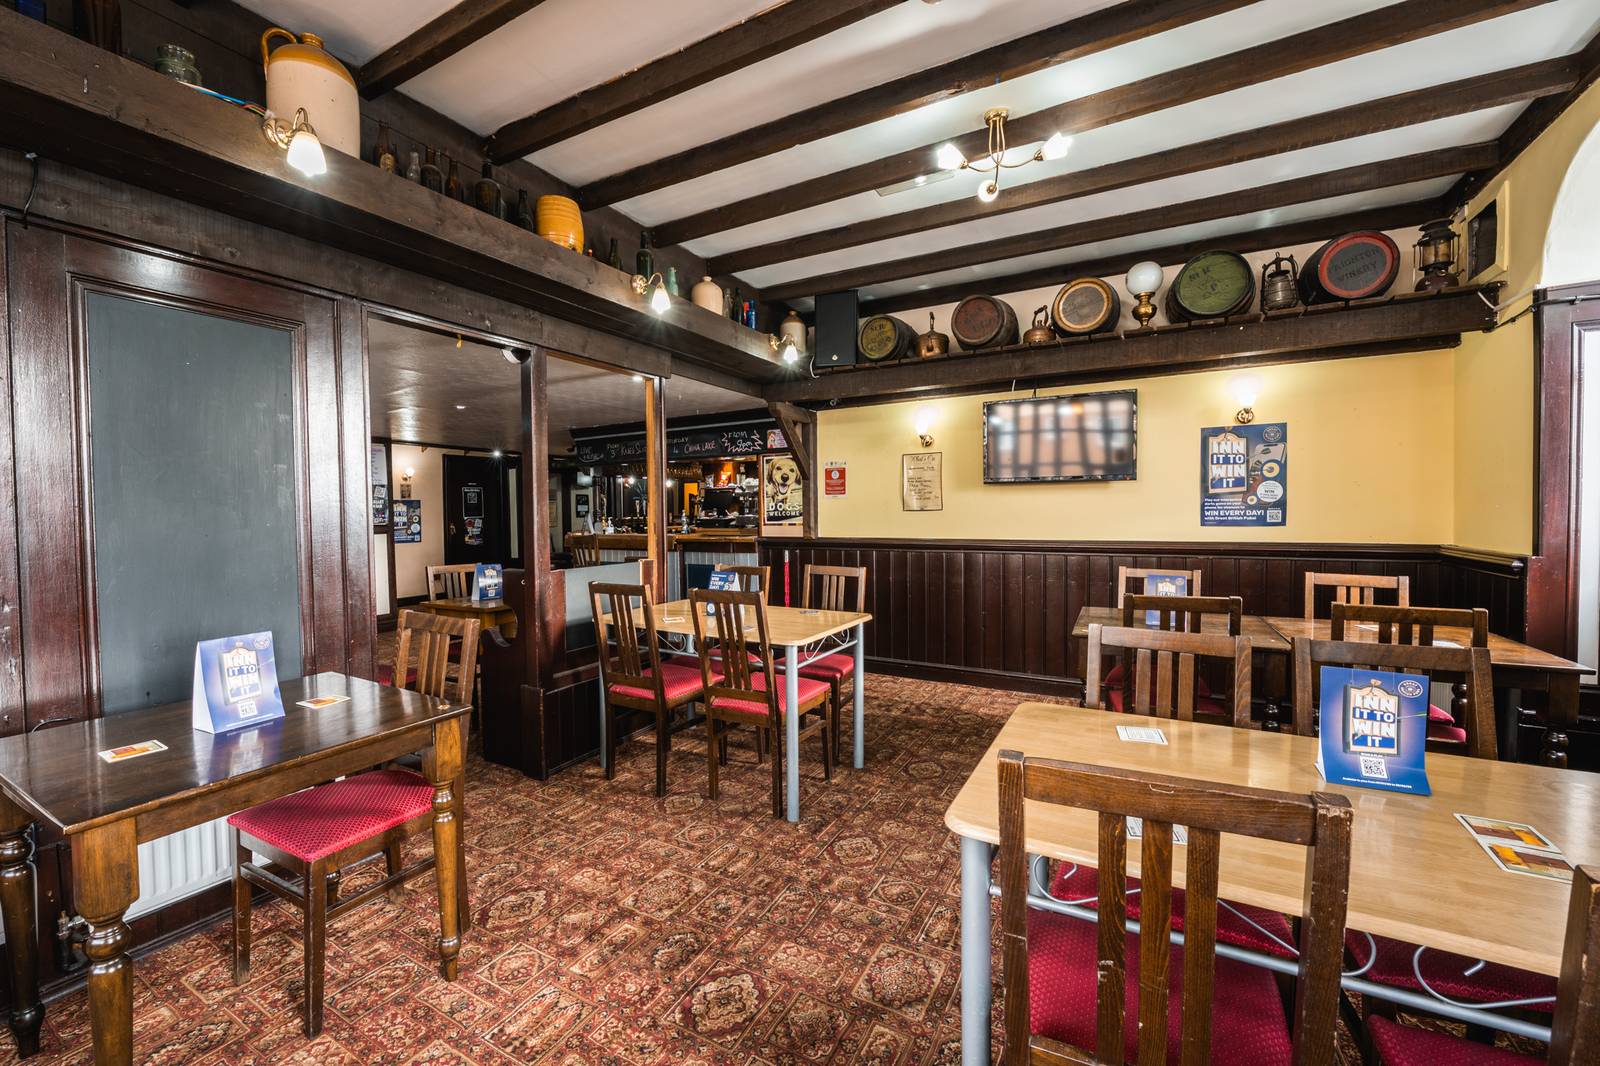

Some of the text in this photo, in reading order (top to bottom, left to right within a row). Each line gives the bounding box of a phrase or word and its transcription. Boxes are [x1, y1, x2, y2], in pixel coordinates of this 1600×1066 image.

[728, 431, 748, 439] FROM
[1212, 440, 1243, 454] INN
[1213, 454, 1245, 464] IT TO
[1212, 464, 1246, 478] WIN
[1222, 478, 1235, 488] IT
[769, 502, 800, 511] DOGS
[228, 665, 256, 677] IT TO
[240, 685, 251, 694] IT
[1355, 694, 1393, 711] INN
[1355, 707, 1394, 722] IT TO
[1353, 719, 1393, 737] WIN
[1367, 736, 1382, 747] IT
